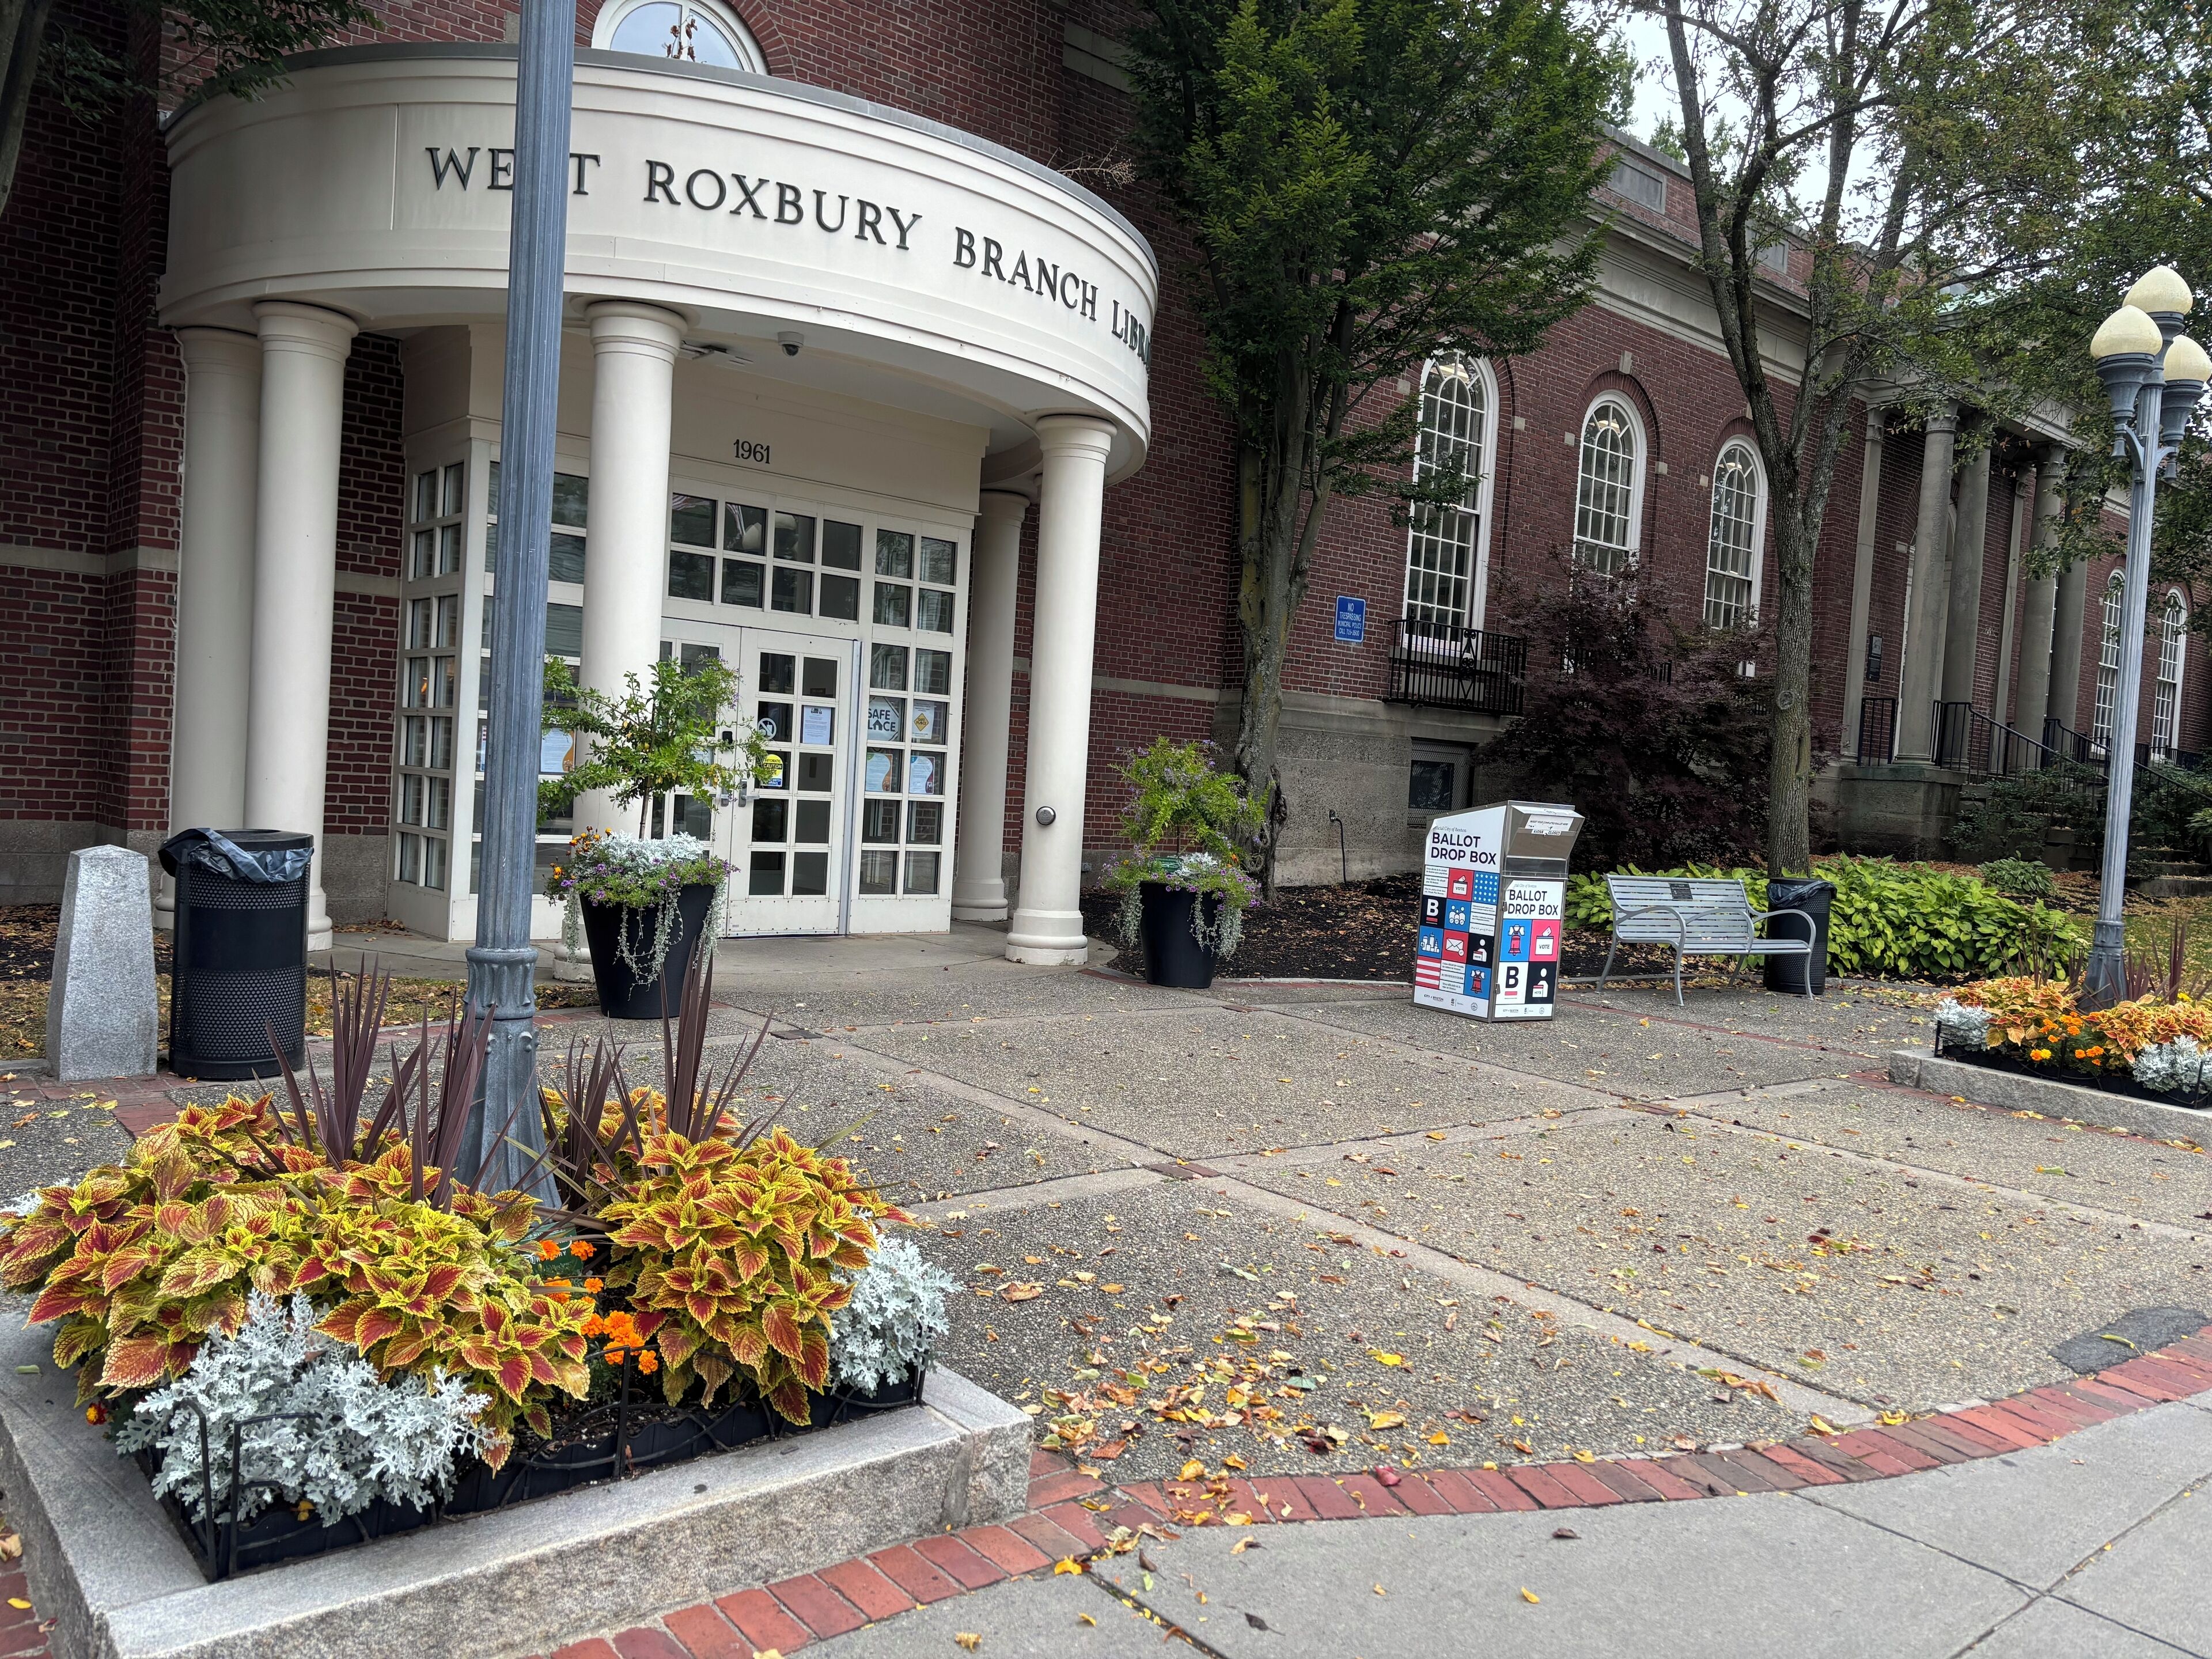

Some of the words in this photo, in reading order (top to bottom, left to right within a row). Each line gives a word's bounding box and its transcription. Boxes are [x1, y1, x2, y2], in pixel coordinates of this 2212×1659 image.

[425, 147, 601, 195] WET
[643, 160, 923, 250] ROXBURY
[953, 226, 1099, 321] BRANCH
[733, 439, 770, 464] 1961
[1347, 603, 1354, 612] NO
[1339, 612, 1361, 622] TRESPASSING
[868, 708, 891, 720] SAFE
[1432, 832, 1481, 848] BALLOT
[1431, 846, 1466, 861] DROP
[1469, 850, 1497, 865] BOX
[1509, 889, 1548, 902] BALLOT
[1426, 899, 1439, 916] B
[1508, 903, 1536, 915] DROP
[1539, 904, 1559, 916] BOX
[1505, 966, 1519, 988] B
